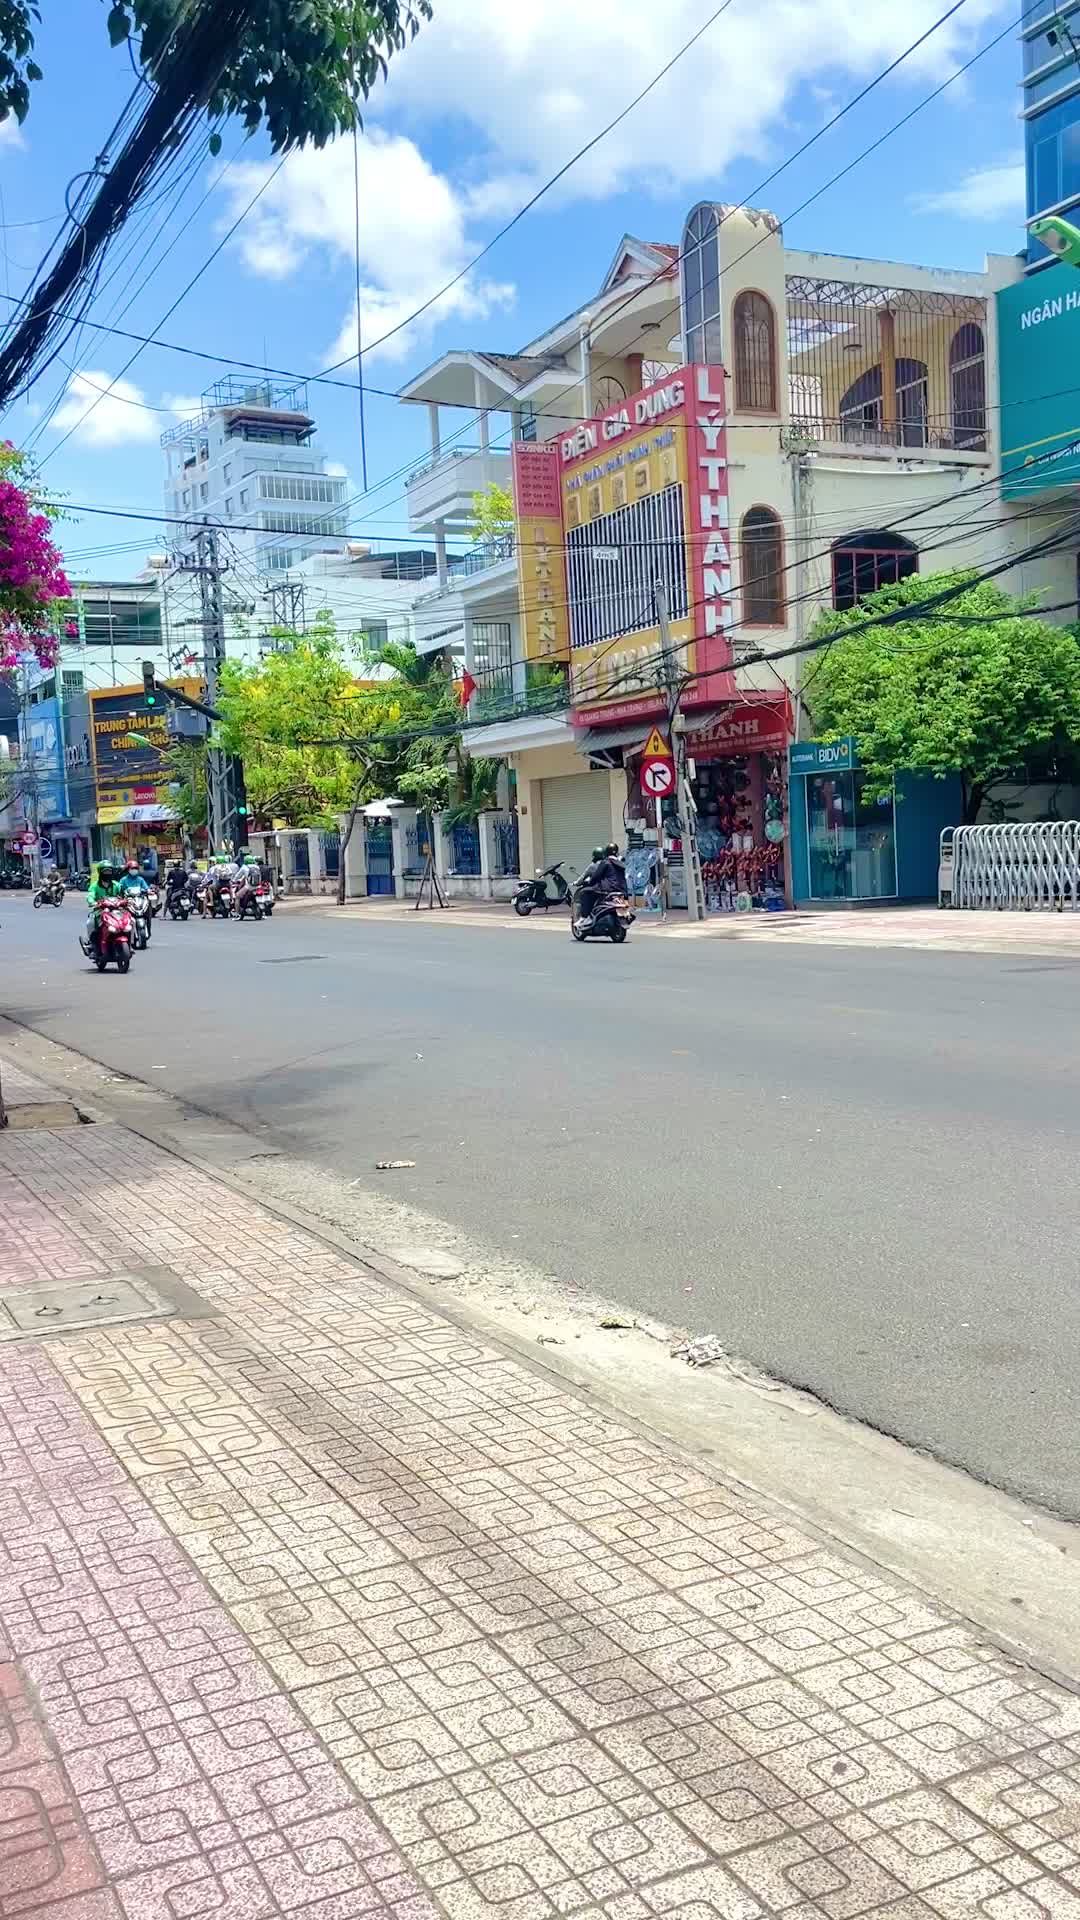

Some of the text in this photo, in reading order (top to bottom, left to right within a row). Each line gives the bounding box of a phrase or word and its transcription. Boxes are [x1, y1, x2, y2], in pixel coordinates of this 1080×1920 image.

[1021, 299, 1062, 330] NGÂN
[602, 408, 632, 440] GIA
[635, 381, 685, 425] DỤNG
[95, 720, 127, 733] TRUNG
[688, 719, 759, 743] THANH
[819, 747, 840, 762] BIDV
